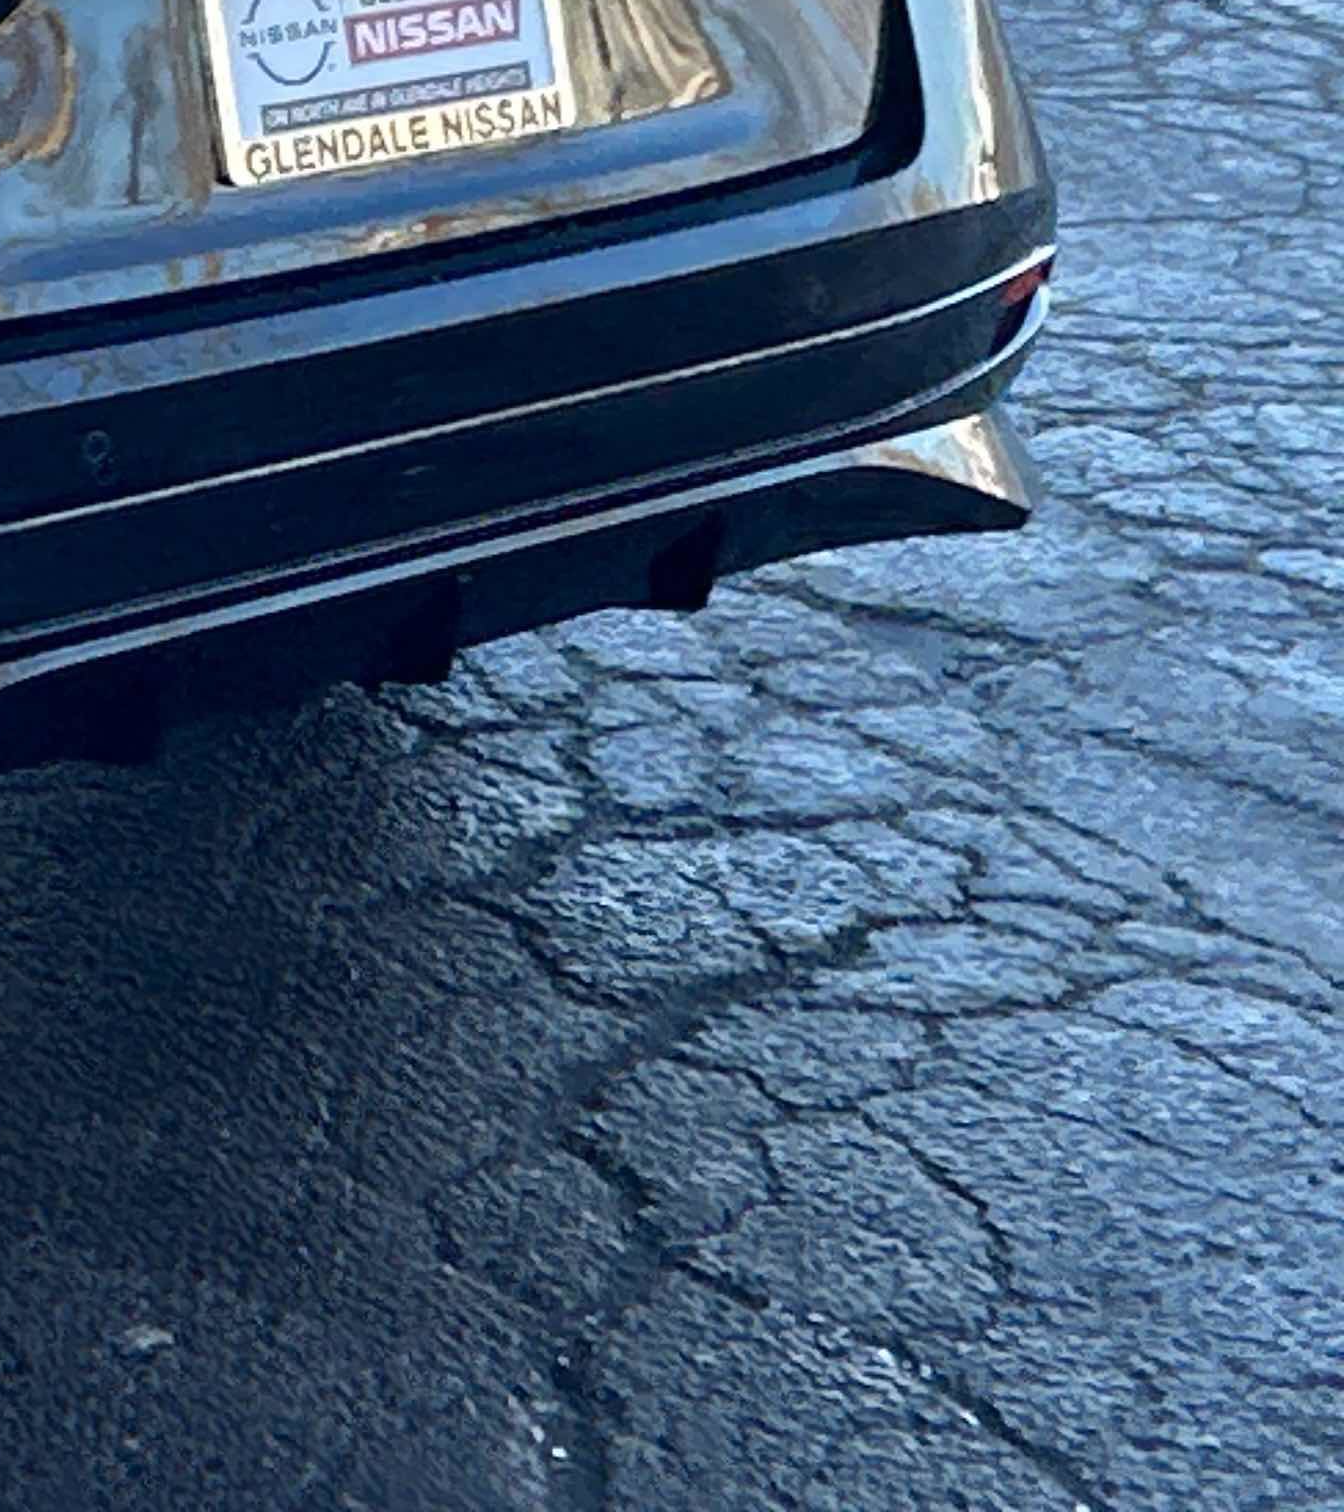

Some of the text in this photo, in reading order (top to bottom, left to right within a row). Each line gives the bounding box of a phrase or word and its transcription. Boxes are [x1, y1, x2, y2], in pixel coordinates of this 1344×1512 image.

[238, 18, 338, 48] NISSAN
[353, 0, 514, 58] NISSAN
[244, 91, 563, 180] GLENDALE NISSAN
